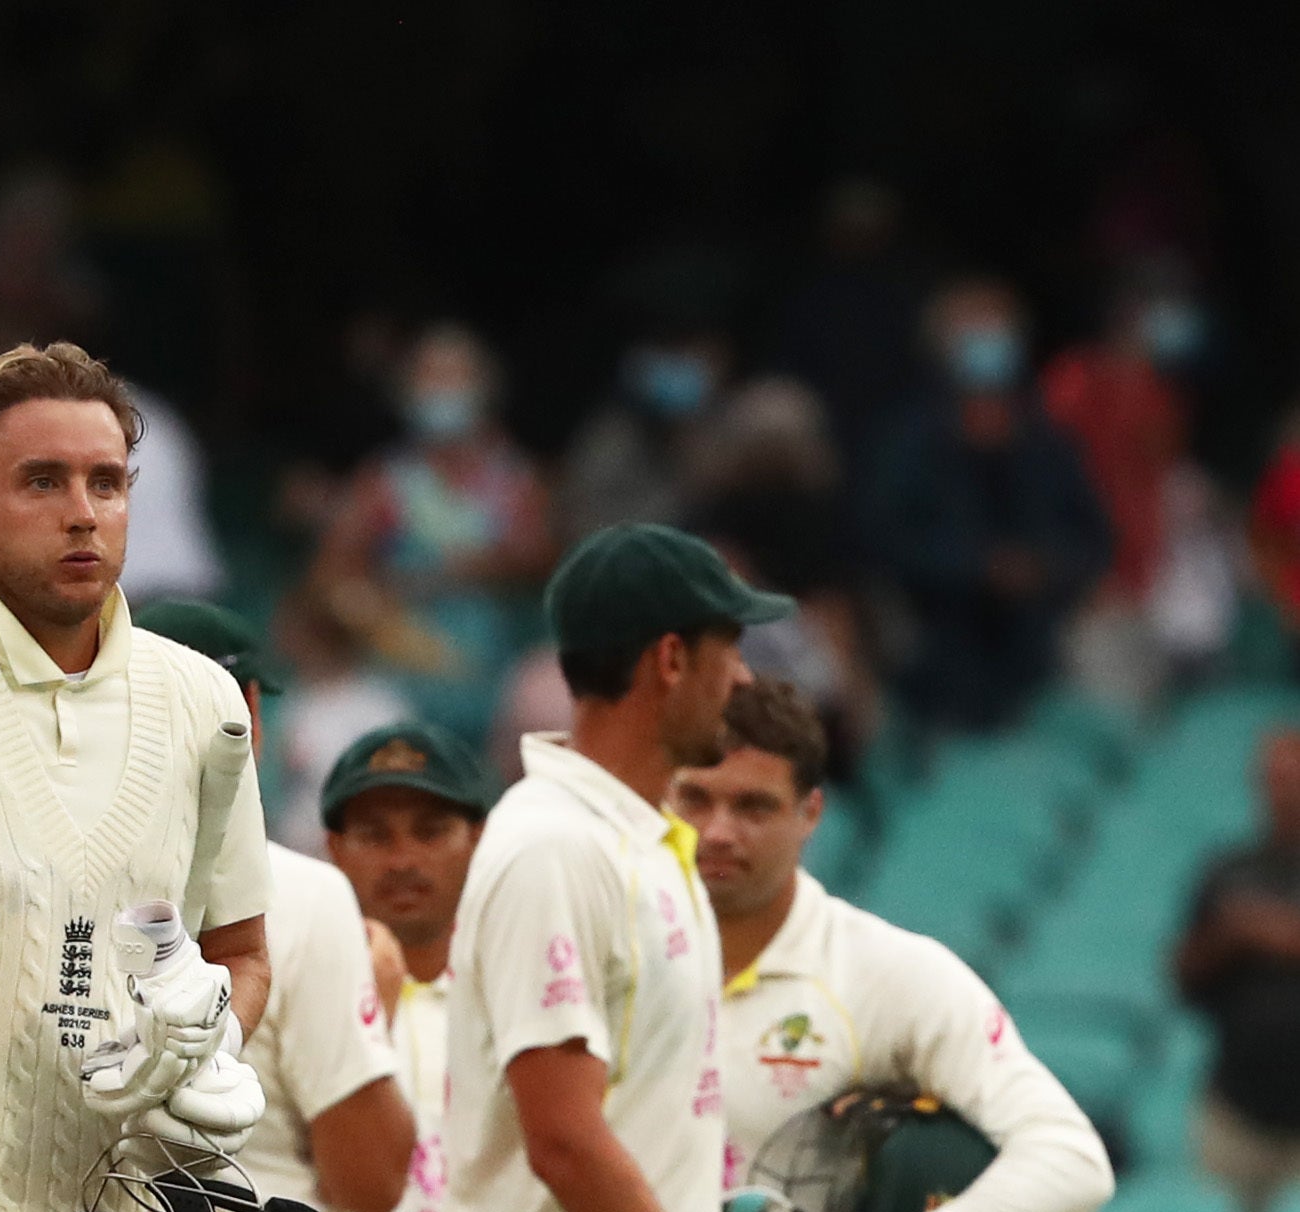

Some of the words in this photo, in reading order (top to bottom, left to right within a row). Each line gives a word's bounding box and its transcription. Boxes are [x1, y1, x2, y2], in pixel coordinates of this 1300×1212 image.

[41, 1003, 75, 1016] ASHES
[77, 1006, 110, 1021] SERIES
[58, 1017, 91, 1030] 2021/22
[61, 1033, 85, 1048] 638
